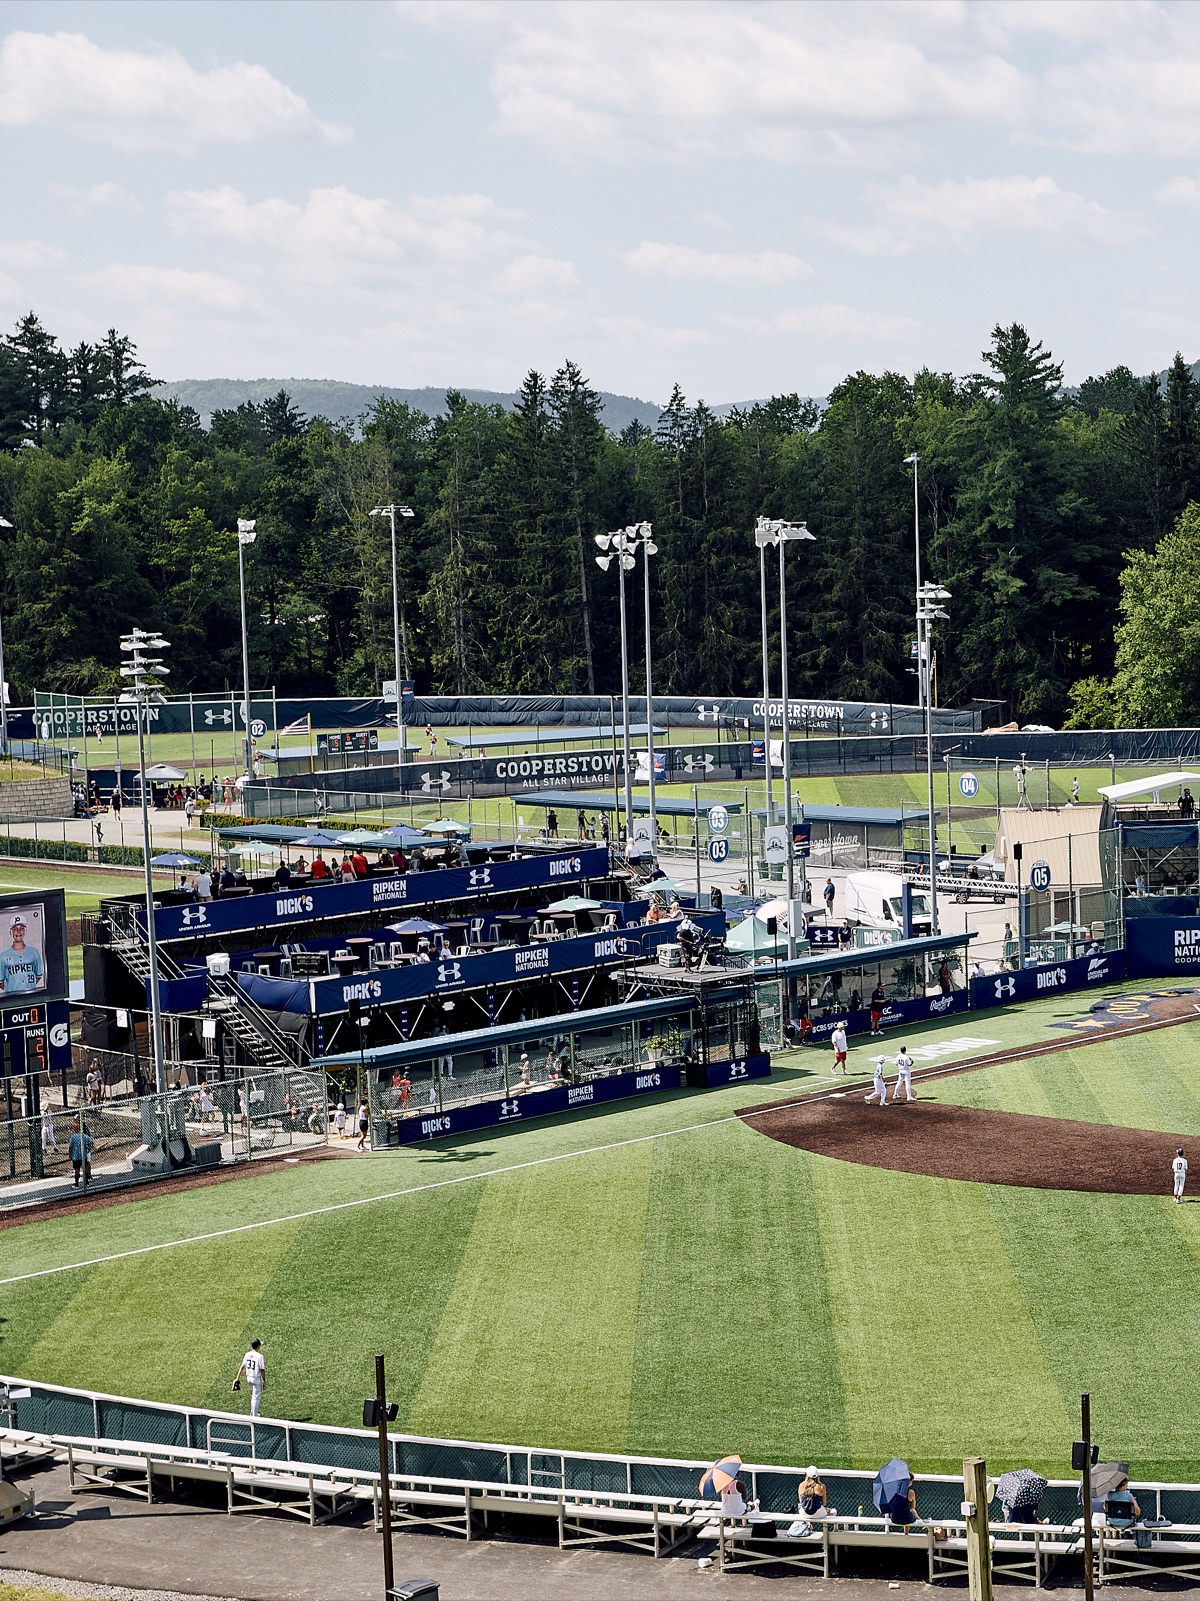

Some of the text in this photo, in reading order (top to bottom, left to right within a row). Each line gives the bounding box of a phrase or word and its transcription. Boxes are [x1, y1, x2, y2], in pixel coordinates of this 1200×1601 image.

[32, 708, 159, 725] COOPERSTOWN
[753, 703, 844, 719] COOPERSTOWN
[101, 723, 137, 732] VILLAGE
[252, 723, 264, 735] 02
[522, 774, 610, 788] ALL STAR VILLAGE
[962, 779, 975, 793] 04
[711, 812, 725, 828] 03
[712, 841, 726, 858] 03
[549, 857, 581, 876] DICK'S
[1034, 867, 1047, 887] 05
[372, 879, 407, 895] RIPKEN
[373, 890, 407, 902] NATIONALS
[276, 895, 314, 916] DICK'S
[863, 931, 893, 945] DICK'S
[594, 936, 627, 957] DICK'S
[515, 947, 549, 965] RIPKEN
[515, 959, 549, 973] NATIONALS
[1036, 967, 1066, 989] DICK'S
[343, 979, 382, 1002] DICK'S
[930, 995, 953, 1011] Rawlings
[12, 1008, 38, 1024] OUT 0
[27, 1028, 44, 1038] RUNS
[816, 1023, 827, 1033] CBS
[36, 1038, 44, 1053] 2
[636, 1072, 661, 1089] DICK'S
[568, 1084, 594, 1100] RIPKEN
[568, 1094, 594, 1105] NATIONALS
[421, 1115, 451, 1134] DICK'S
[246, 1359, 256, 1371] 33
